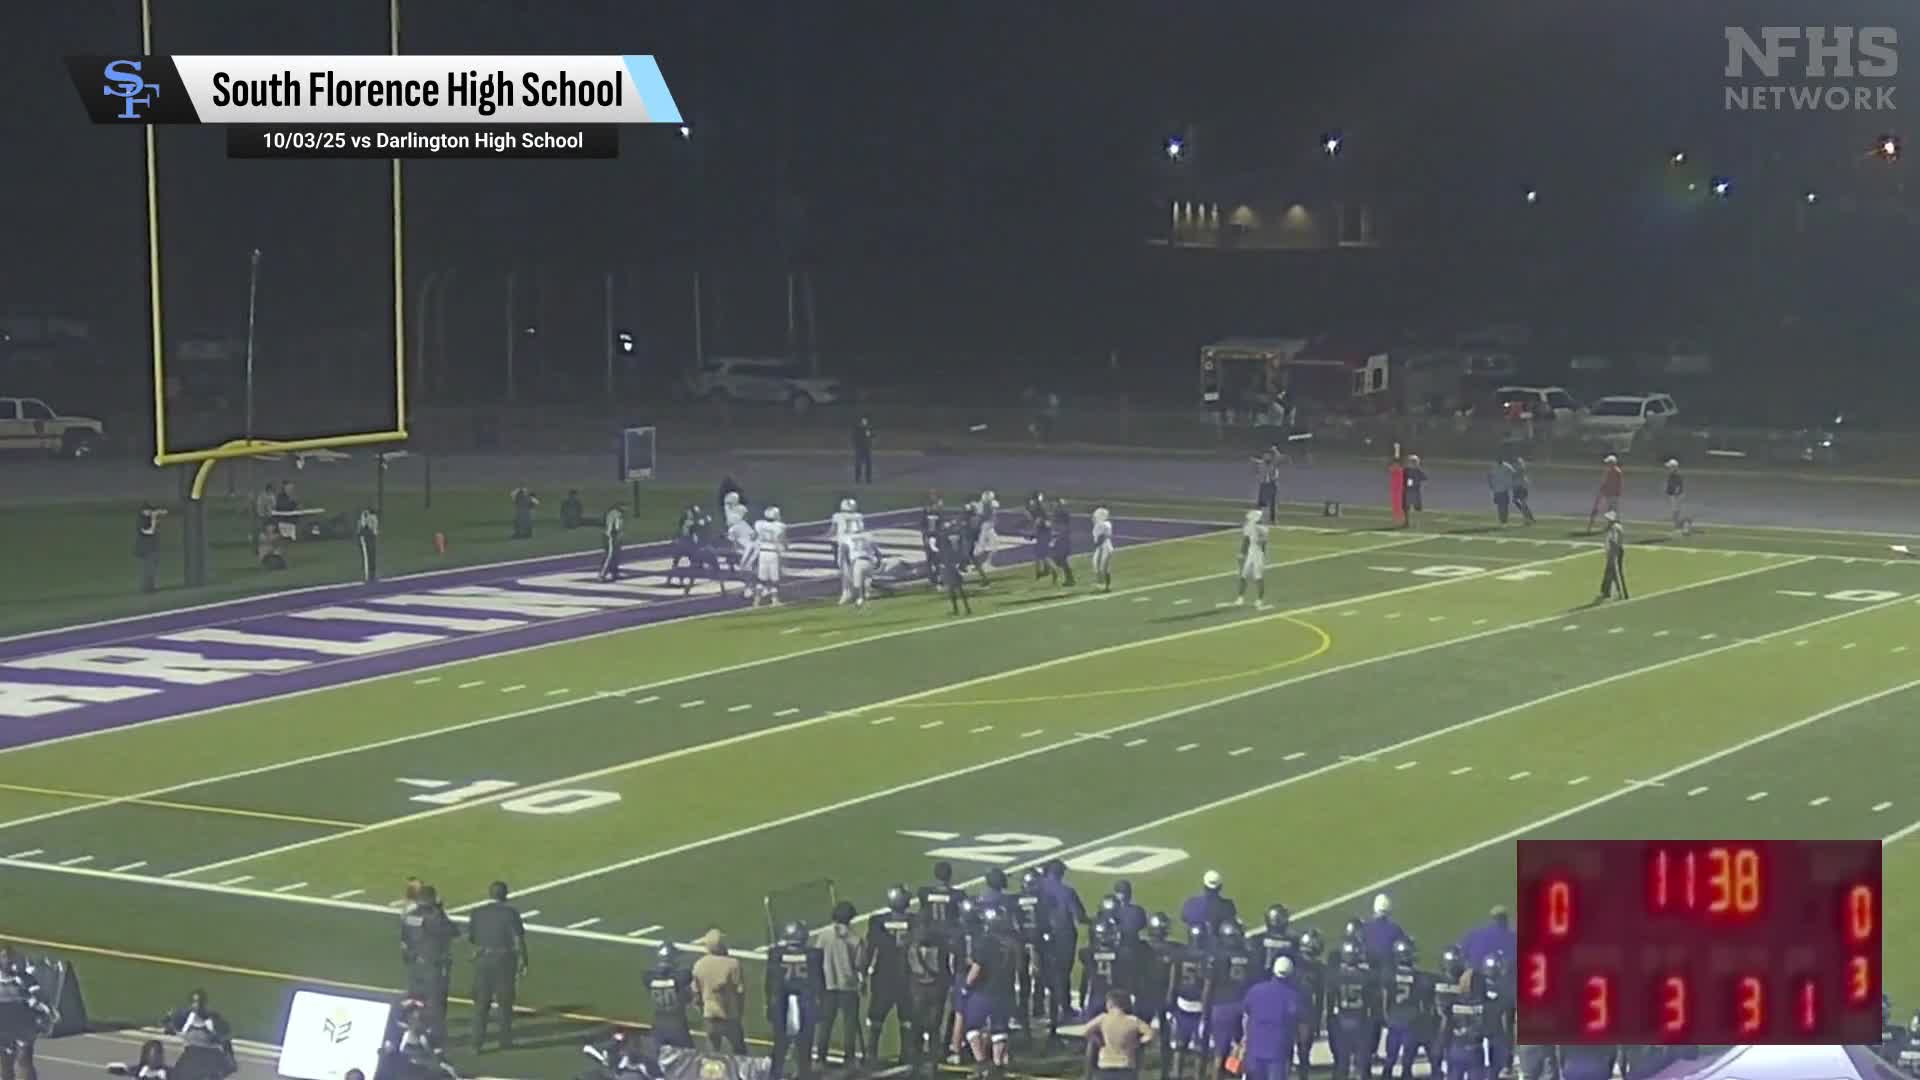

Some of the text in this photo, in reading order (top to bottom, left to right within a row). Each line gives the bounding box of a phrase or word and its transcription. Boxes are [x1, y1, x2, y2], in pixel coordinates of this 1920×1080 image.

[409, 778, 622, 815] 10
[923, 832, 1191, 875] 20
[1548, 880, 1570, 936] 0
[1851, 884, 1873, 940] 0
[1527, 953, 1548, 997] 3
[1850, 955, 1869, 1000] 3
[1586, 976, 1608, 1031] 3
[1664, 976, 1686, 1031] 3
[1742, 976, 1761, 1032] 3
